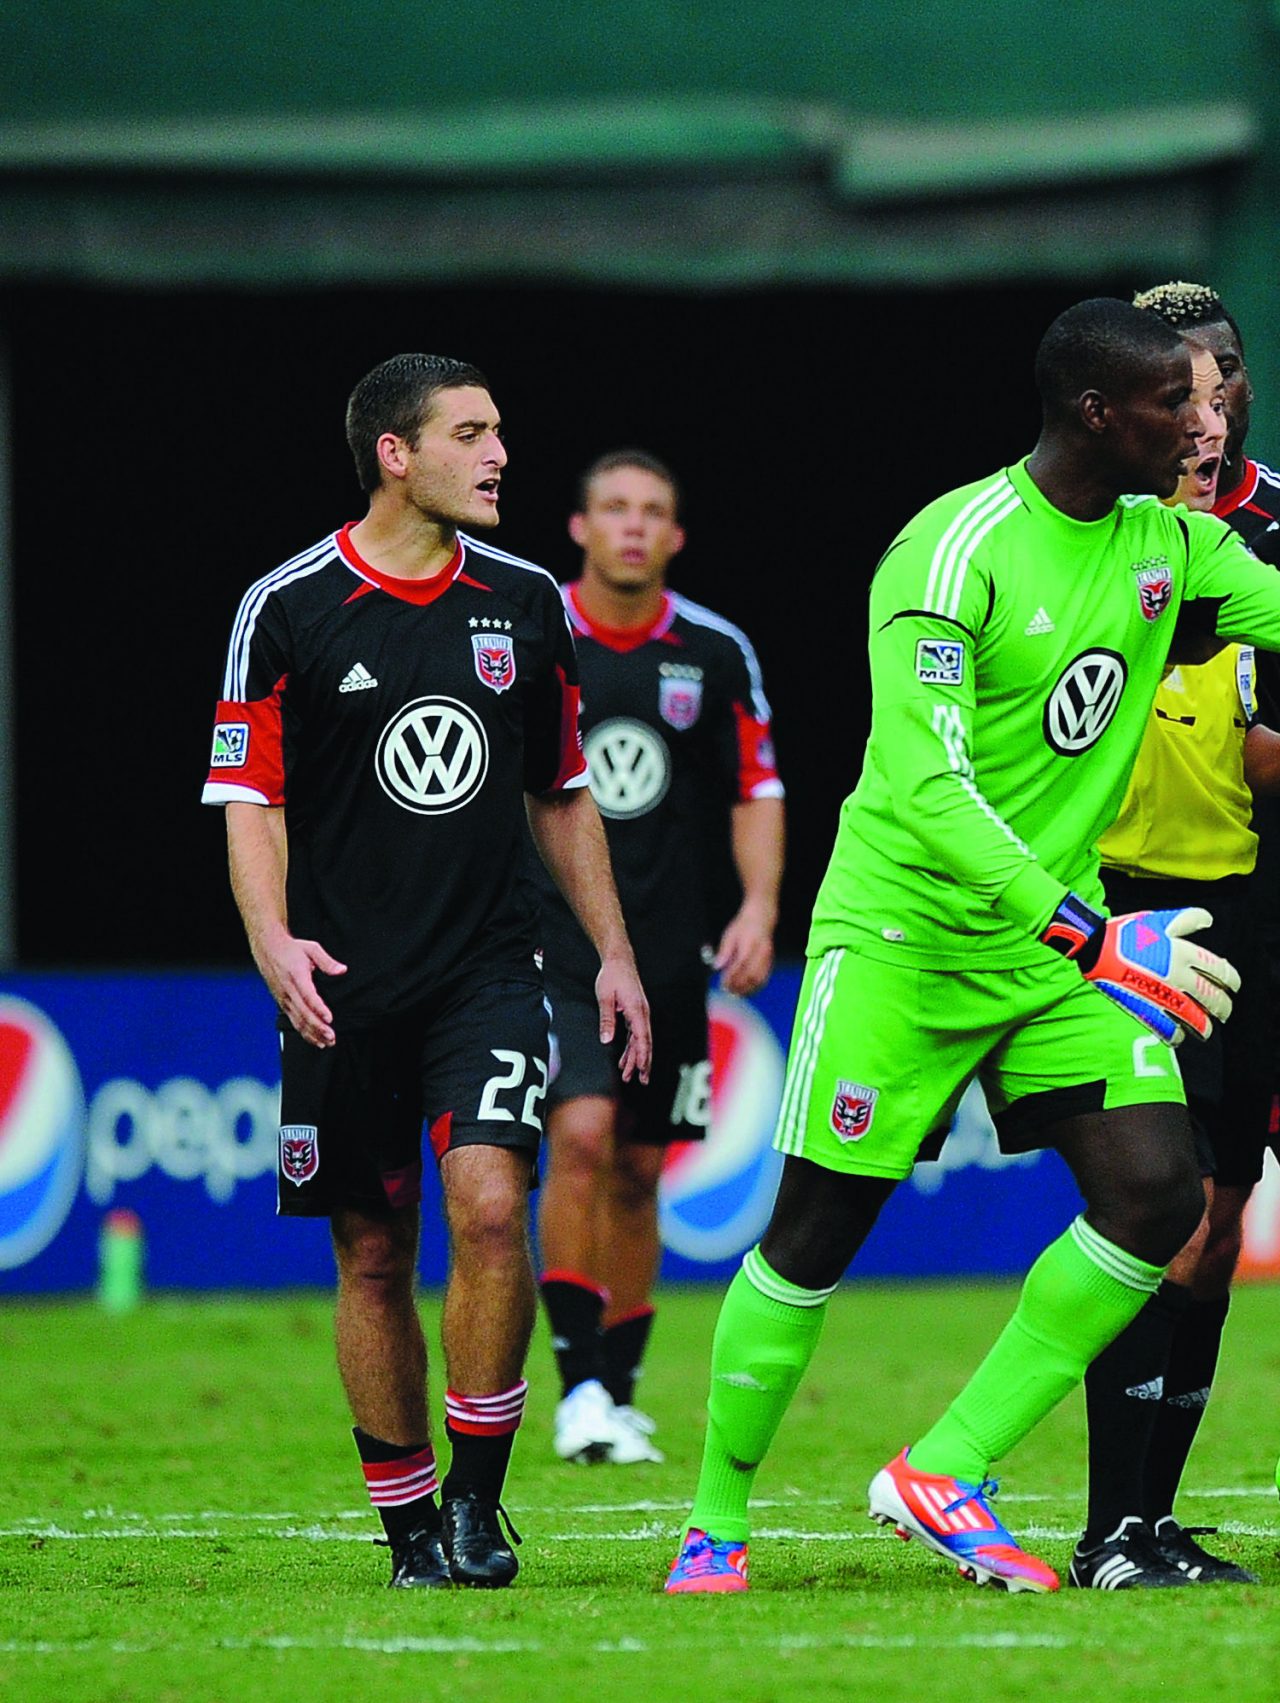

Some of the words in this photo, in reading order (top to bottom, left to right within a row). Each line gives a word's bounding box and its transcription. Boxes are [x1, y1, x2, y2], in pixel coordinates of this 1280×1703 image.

[918, 669, 960, 681] MLS
[338, 677, 379, 694] adidas
[213, 753, 243, 763] MLS
[384, 703, 482, 807] VW
[86, 1073, 280, 1206] pep
